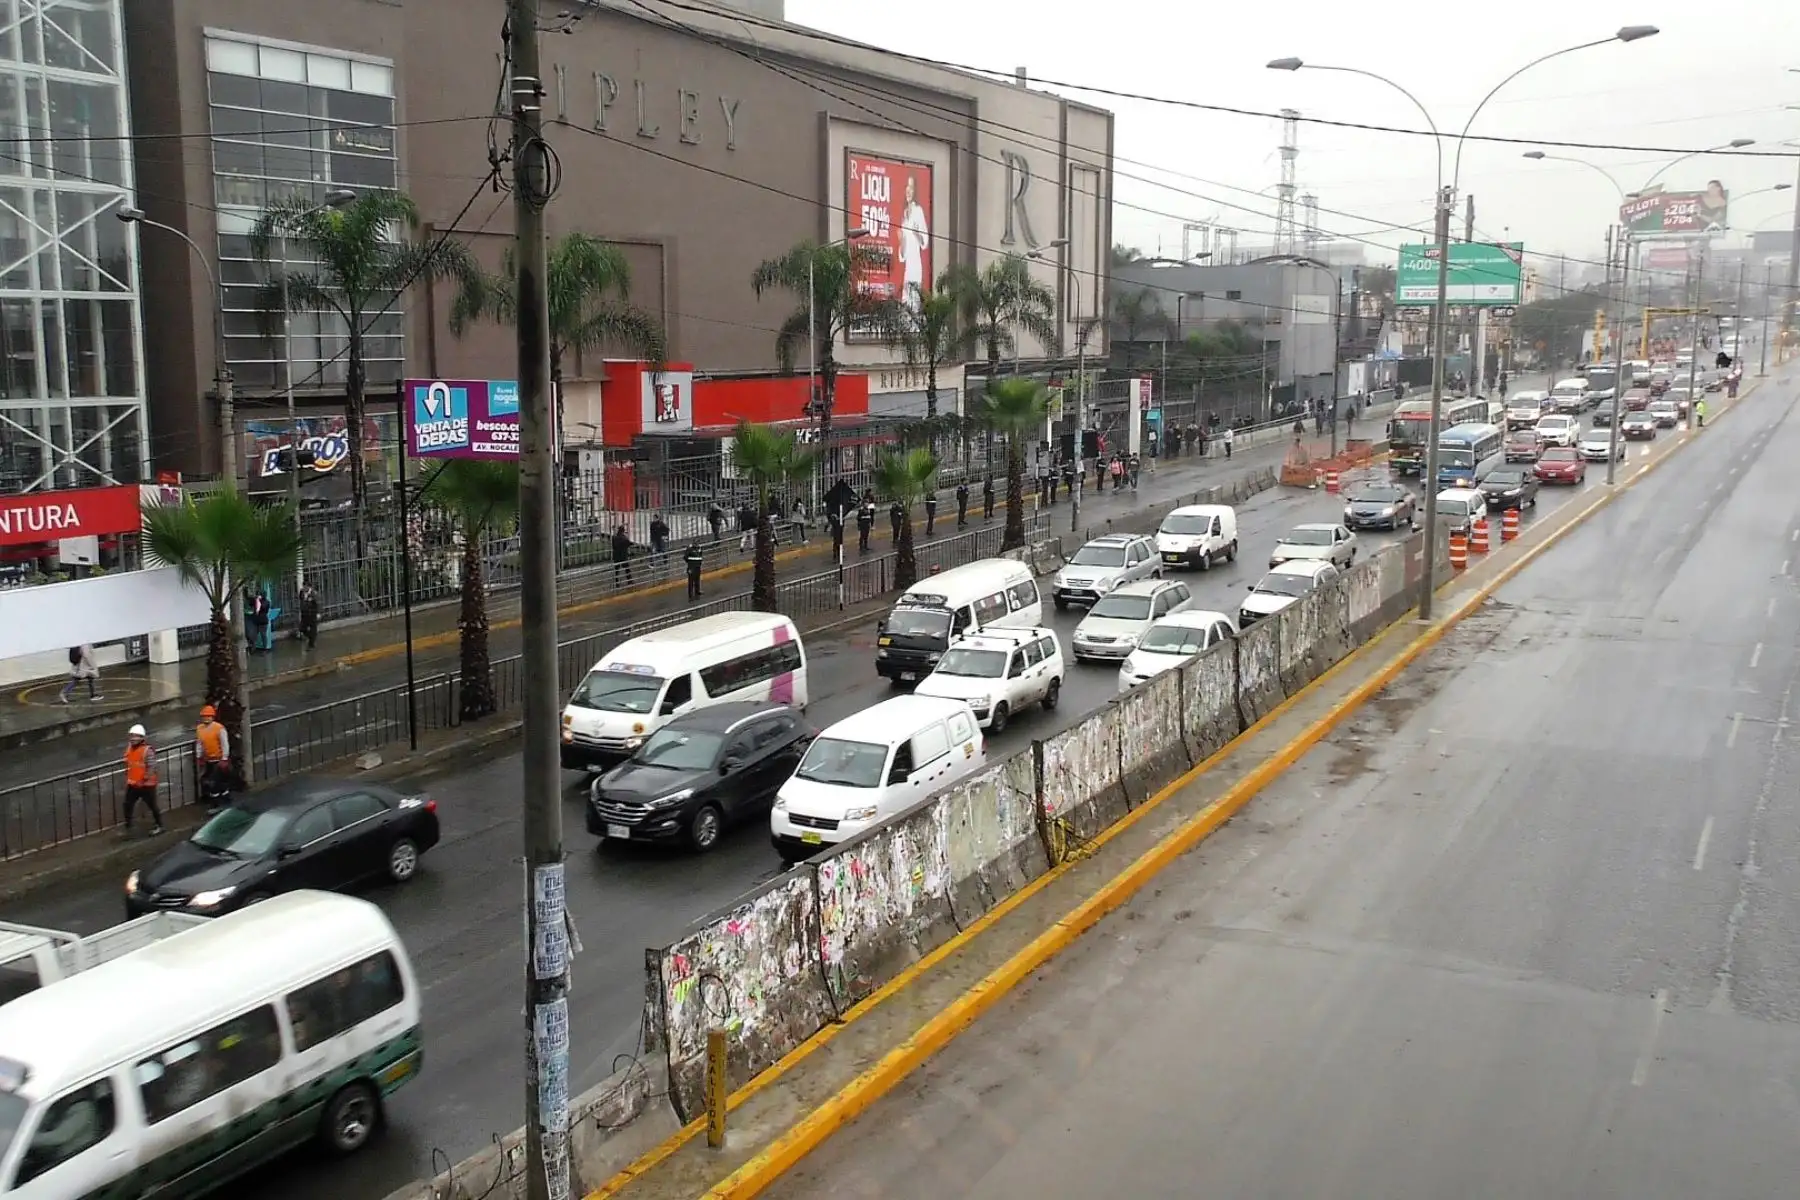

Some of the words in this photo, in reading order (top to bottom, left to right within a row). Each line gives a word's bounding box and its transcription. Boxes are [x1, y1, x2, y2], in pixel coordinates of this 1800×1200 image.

[850, 159, 859, 180] R
[861, 172, 890, 203] LIQUI
[1000, 148, 1039, 249] R
[414, 422, 451, 434] VENTA
[452, 418, 468, 430] DE
[419, 430, 468, 448] DEPAS
